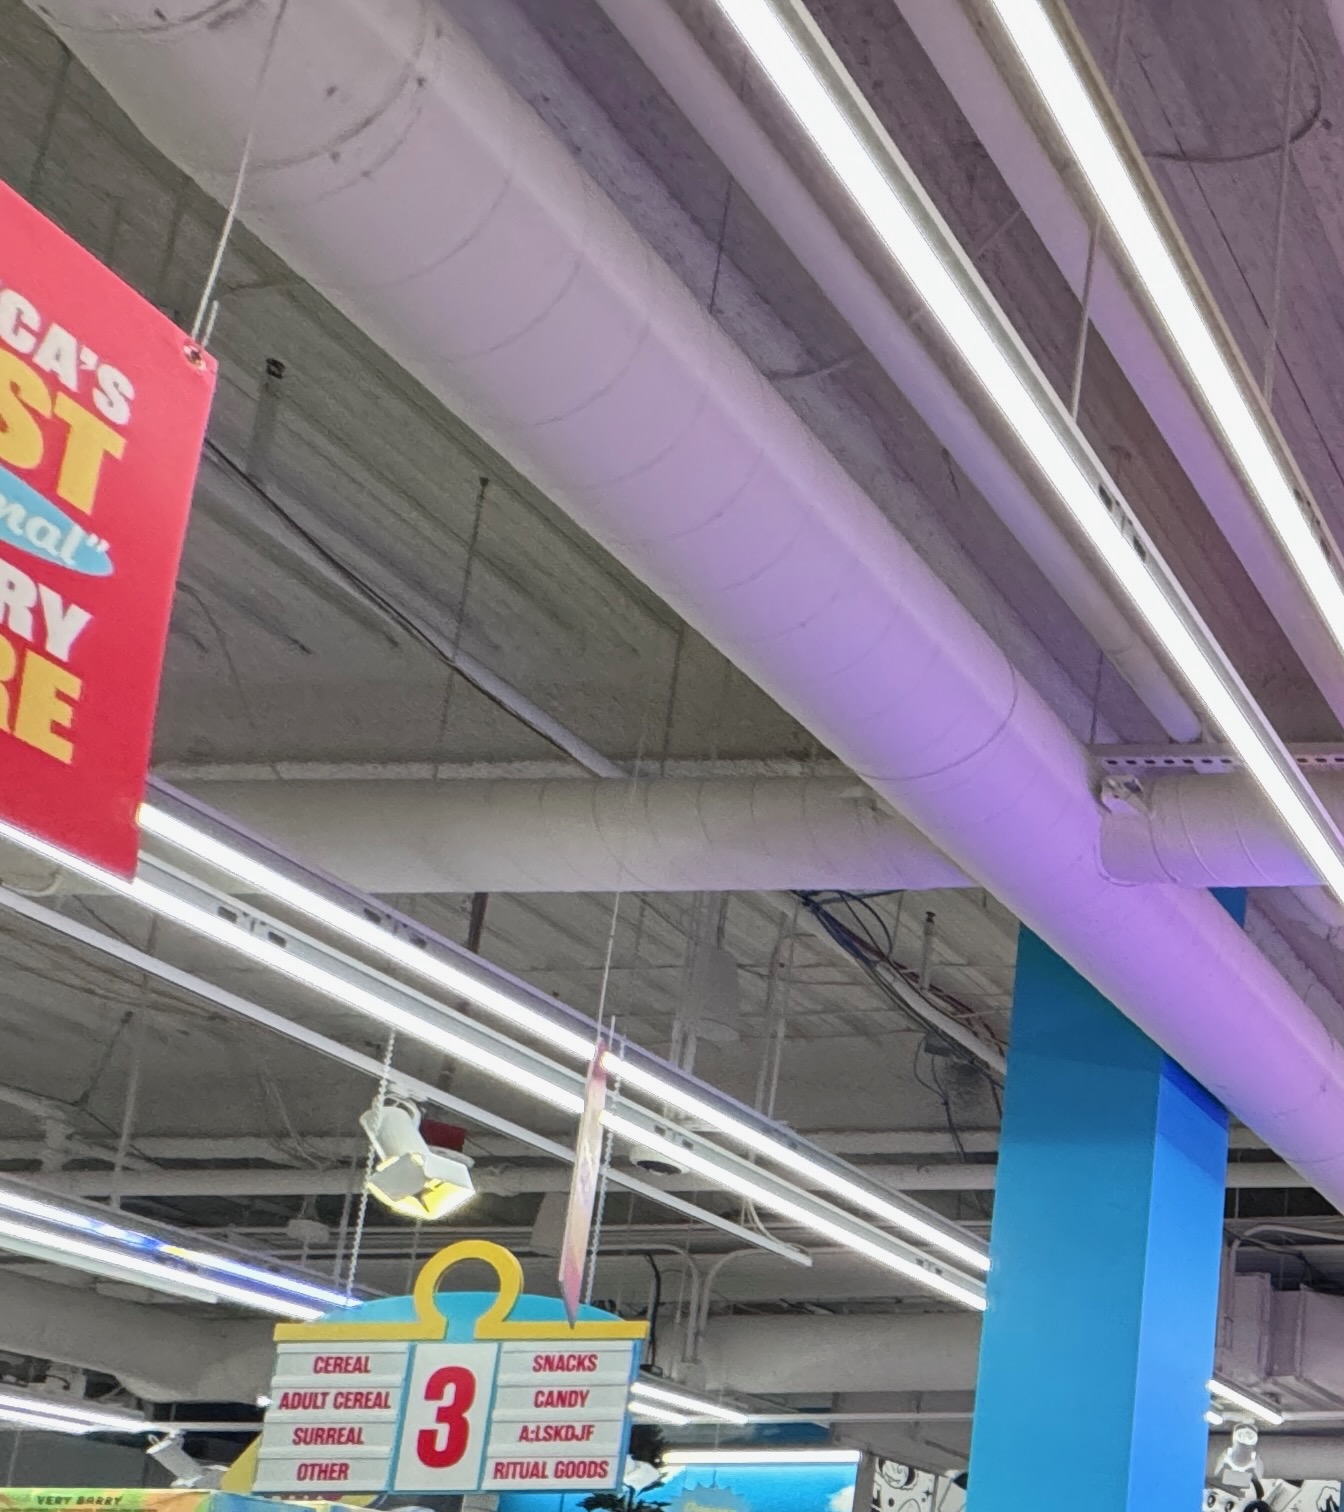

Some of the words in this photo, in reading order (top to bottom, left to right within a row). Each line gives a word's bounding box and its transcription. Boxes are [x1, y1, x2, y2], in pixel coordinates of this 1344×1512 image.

[0, 286, 135, 425] CA'S
[313, 1355, 372, 1374] CEREAL
[533, 1354, 598, 1372] SNACKS
[279, 1391, 330, 1410] ADULT
[333, 1390, 391, 1409] CEREAL
[534, 1390, 590, 1408] CANDY
[416, 1365, 477, 1468] 3
[292, 1426, 365, 1445] SURREAL
[297, 1462, 350, 1481] OTHER
[493, 1461, 550, 1480] RITUAL
[554, 1460, 608, 1478] GOODS
[37, 1495, 73, 1506] VERY
